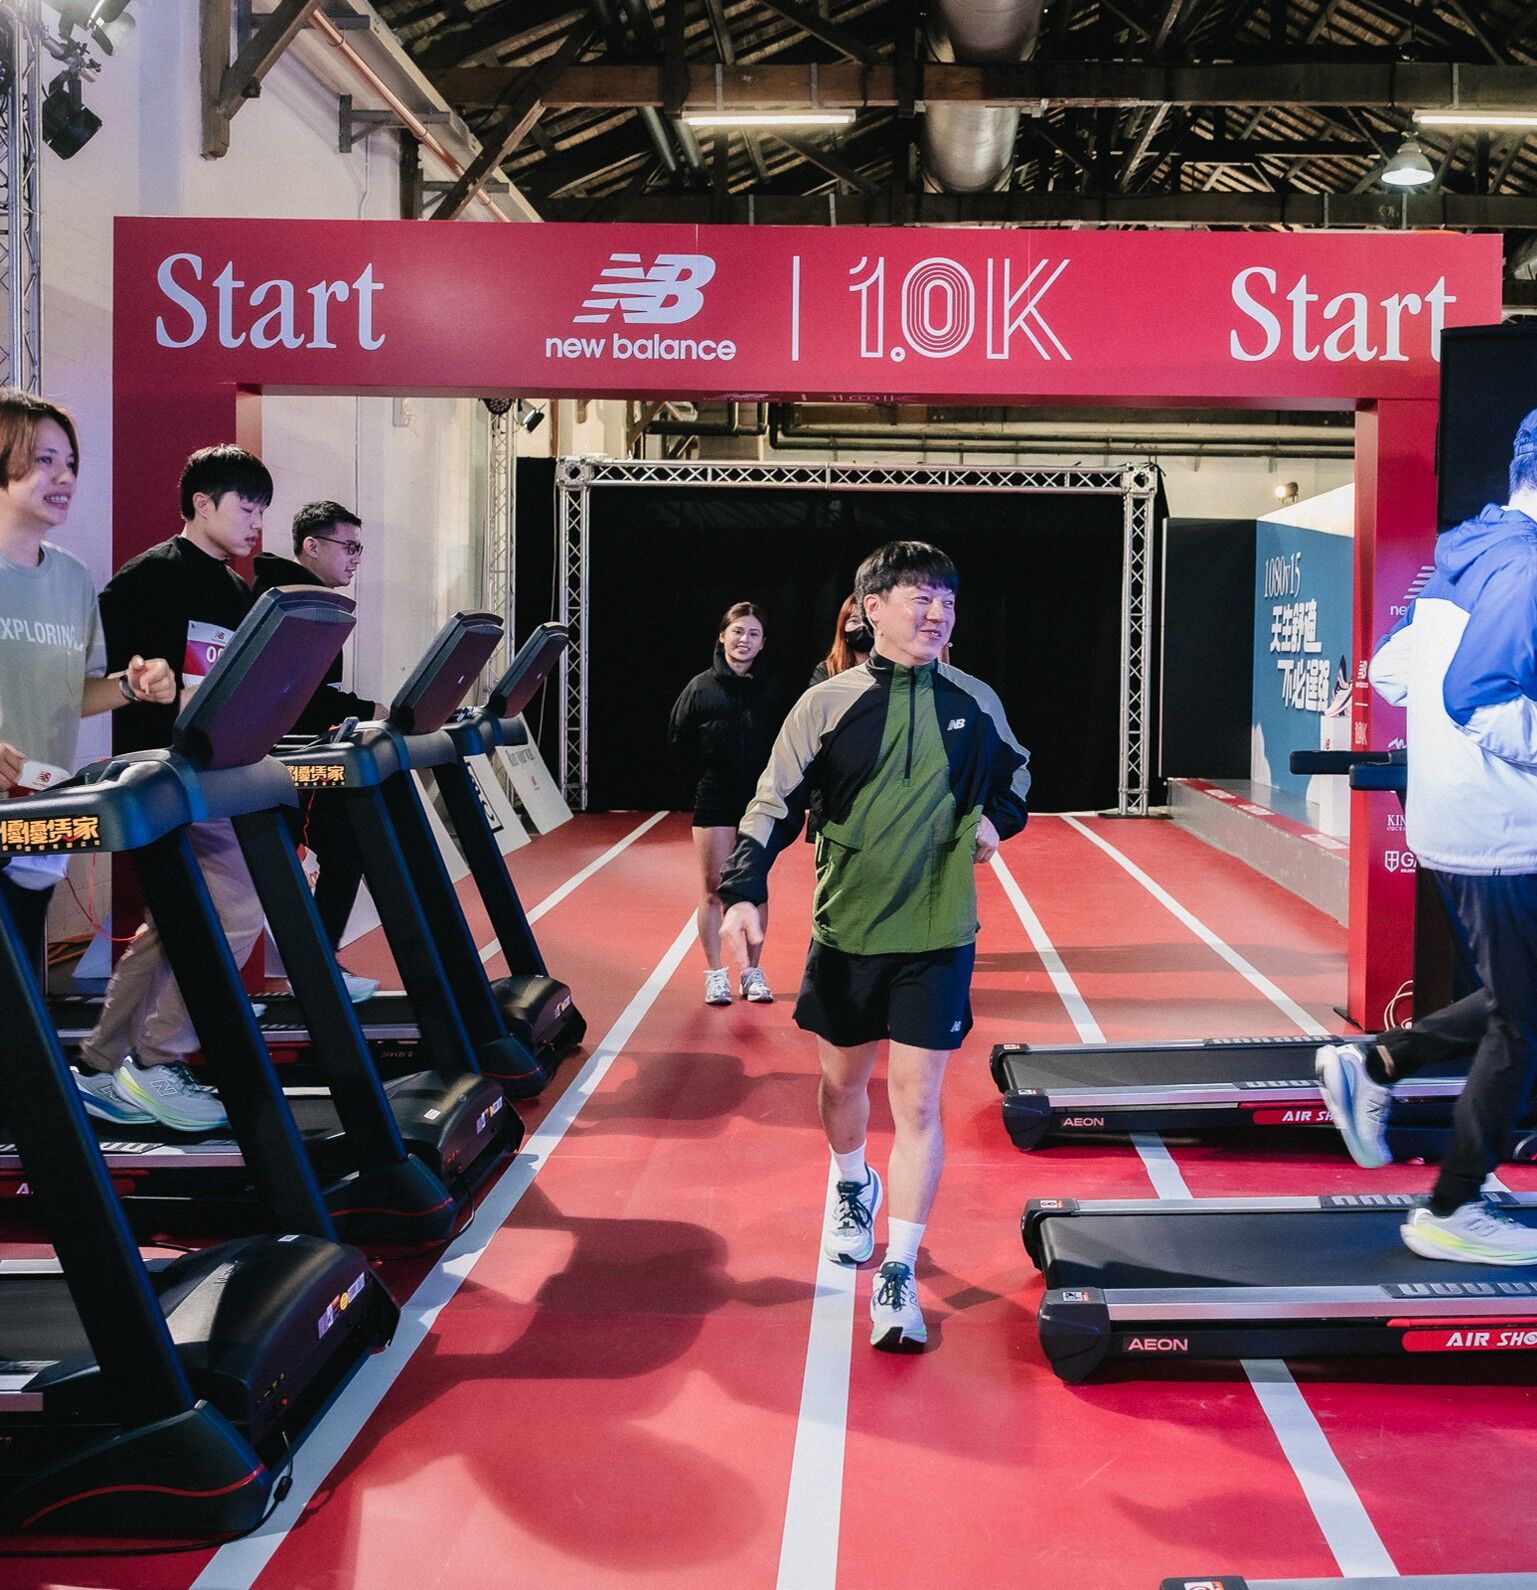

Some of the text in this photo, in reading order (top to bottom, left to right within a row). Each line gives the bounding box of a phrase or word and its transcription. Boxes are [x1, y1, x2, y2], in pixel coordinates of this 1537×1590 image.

[573, 253, 716, 324] NB
[156, 253, 385, 350] Start
[849, 256, 1072, 362] 1.0K
[1230, 266, 1457, 362] Start
[545, 333, 737, 361] new balance
[1390, 604, 1408, 616] ne
[947, 718, 966, 731] NB
[1387, 814, 1406, 827] KIN
[1063, 1117, 1105, 1127] AEON
[1282, 1110, 1312, 1122] AIR
[1127, 1338, 1188, 1352] AEON
[1445, 1331, 1491, 1347] AIR
